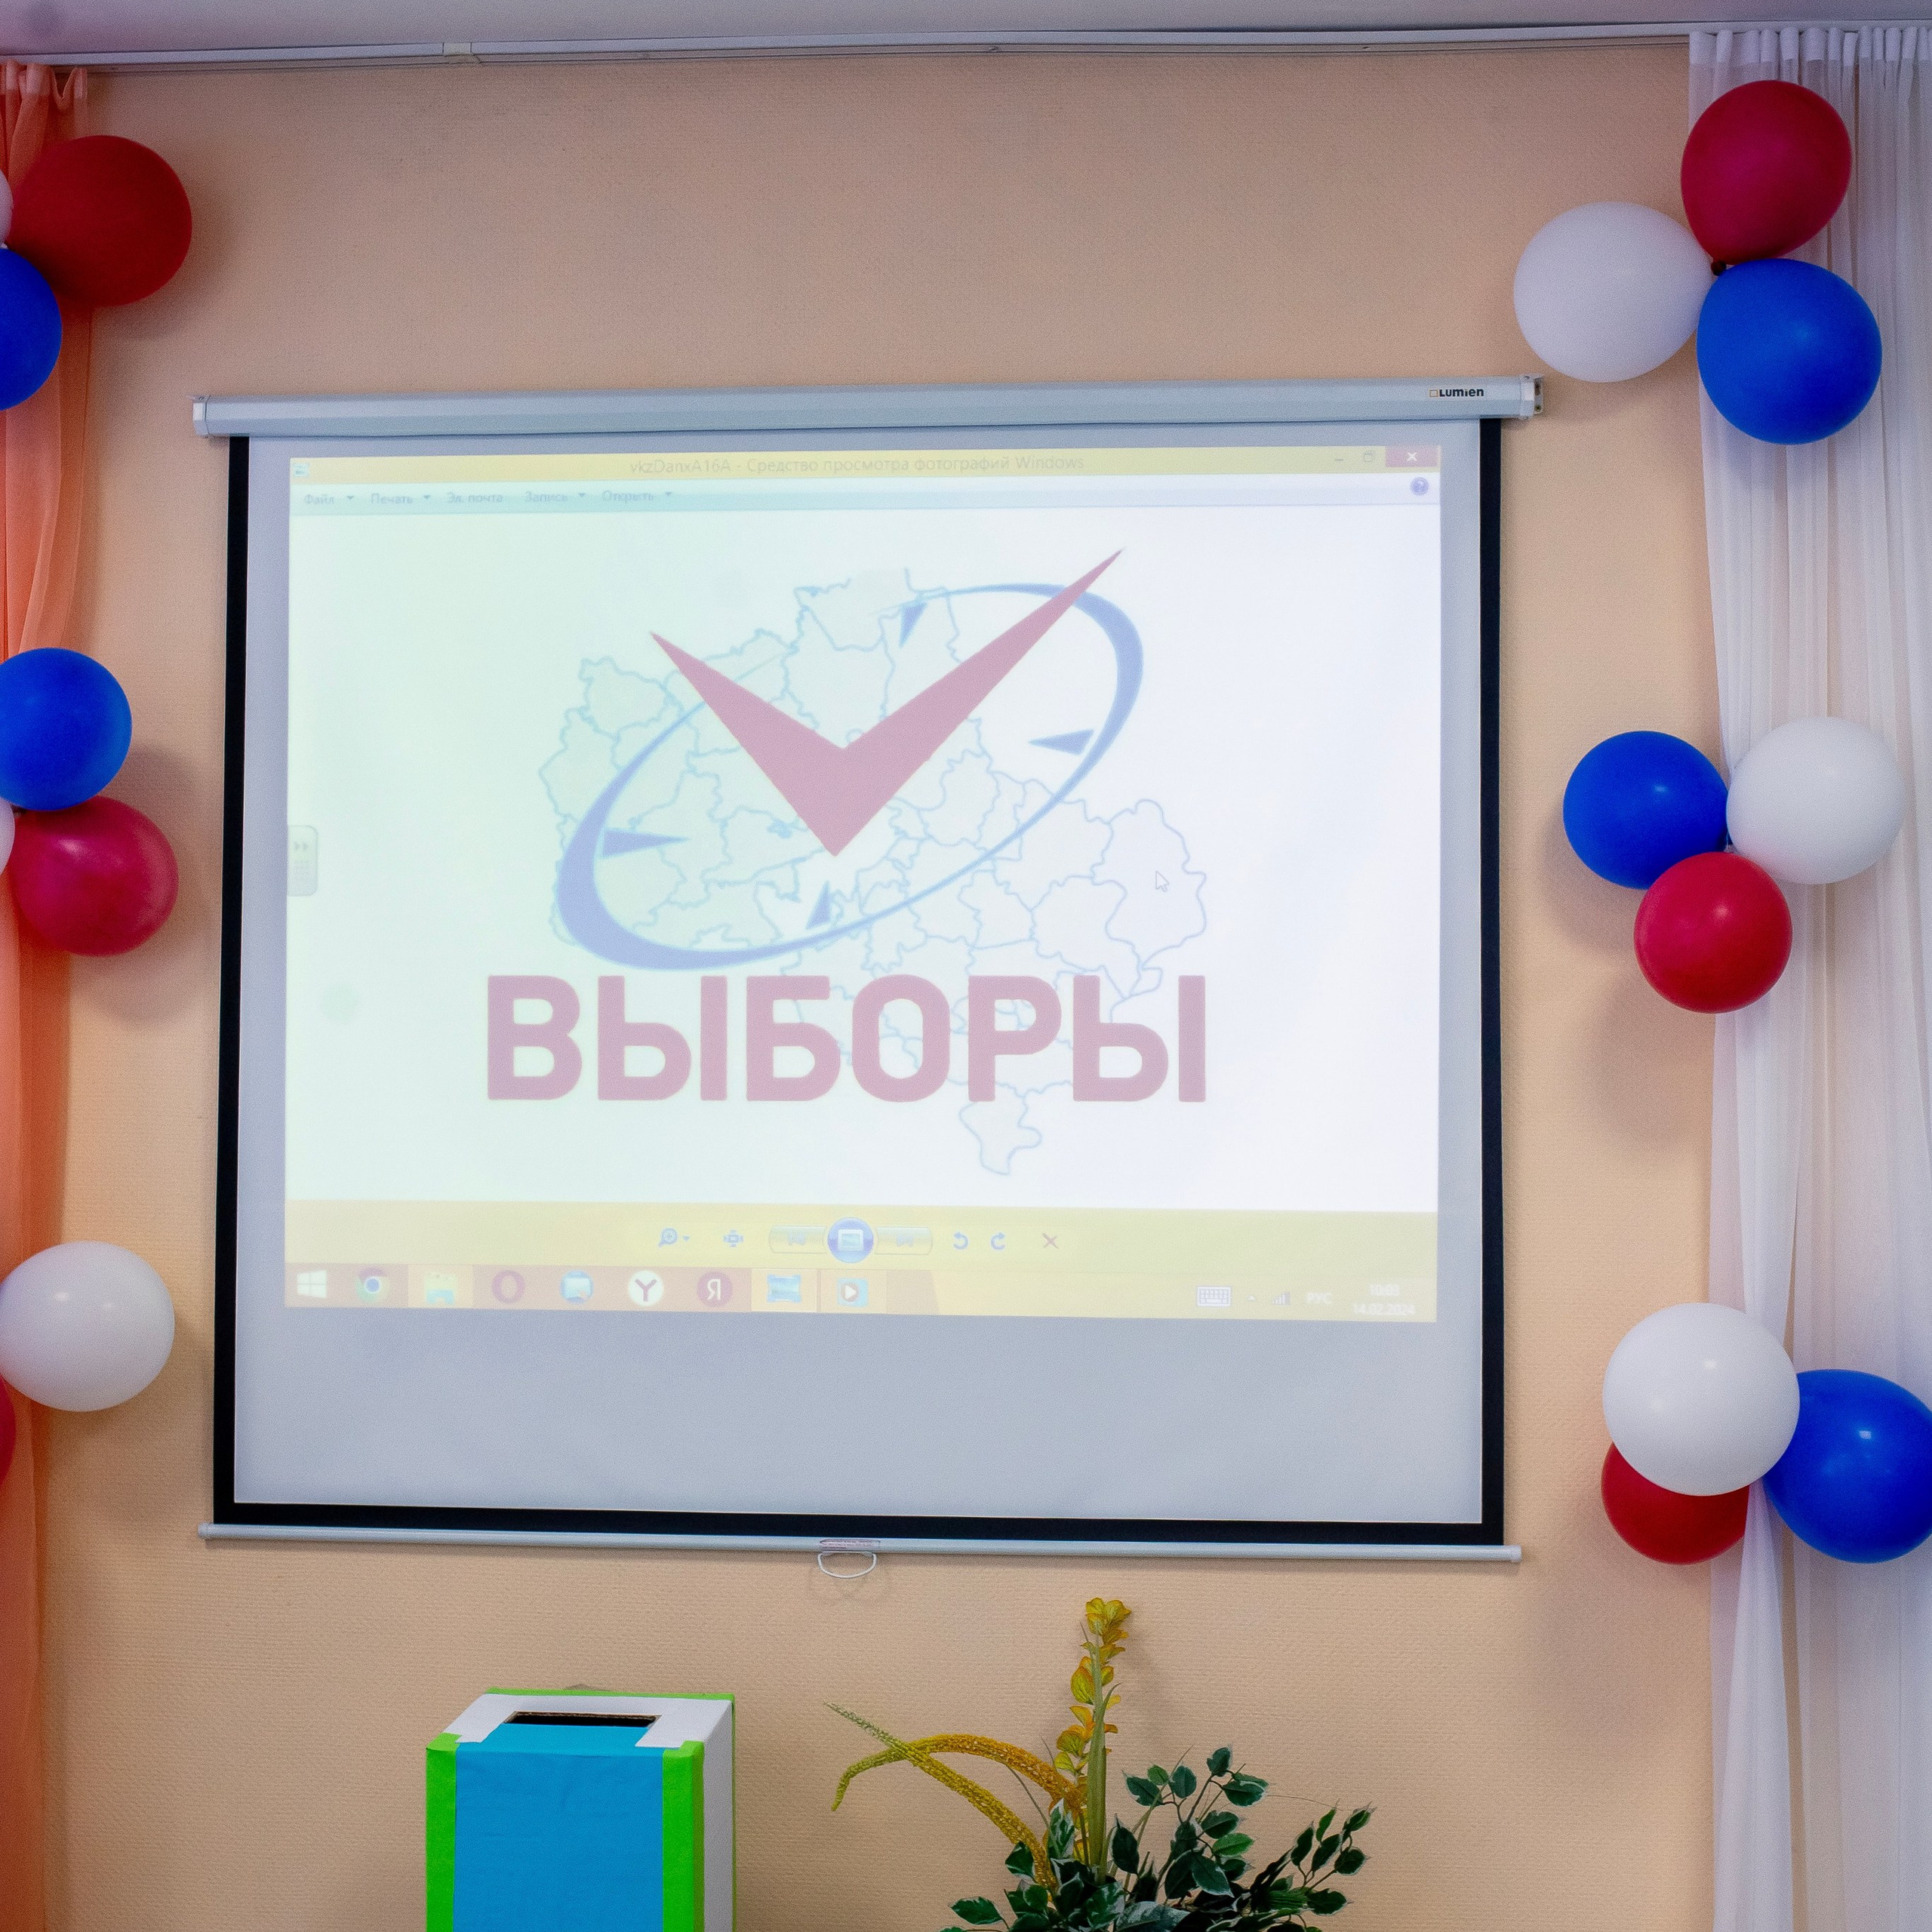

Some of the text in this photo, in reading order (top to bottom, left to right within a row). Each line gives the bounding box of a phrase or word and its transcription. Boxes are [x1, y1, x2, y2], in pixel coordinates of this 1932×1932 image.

[1439, 388, 1484, 398] Lumien
[746, 457, 819, 475] Средство
[823, 459, 909, 475] просмотра
[914, 456, 1010, 473] фотографий
[1015, 455, 1084, 470] Windows
[303, 493, 334, 505] Файл
[371, 492, 414, 505] Печать
[468, 494, 504, 504] почта
[524, 491, 569, 503] Запись
[601, 489, 655, 504] Открыть
[488, 974, 1206, 1102] ВЫБОРЫ
